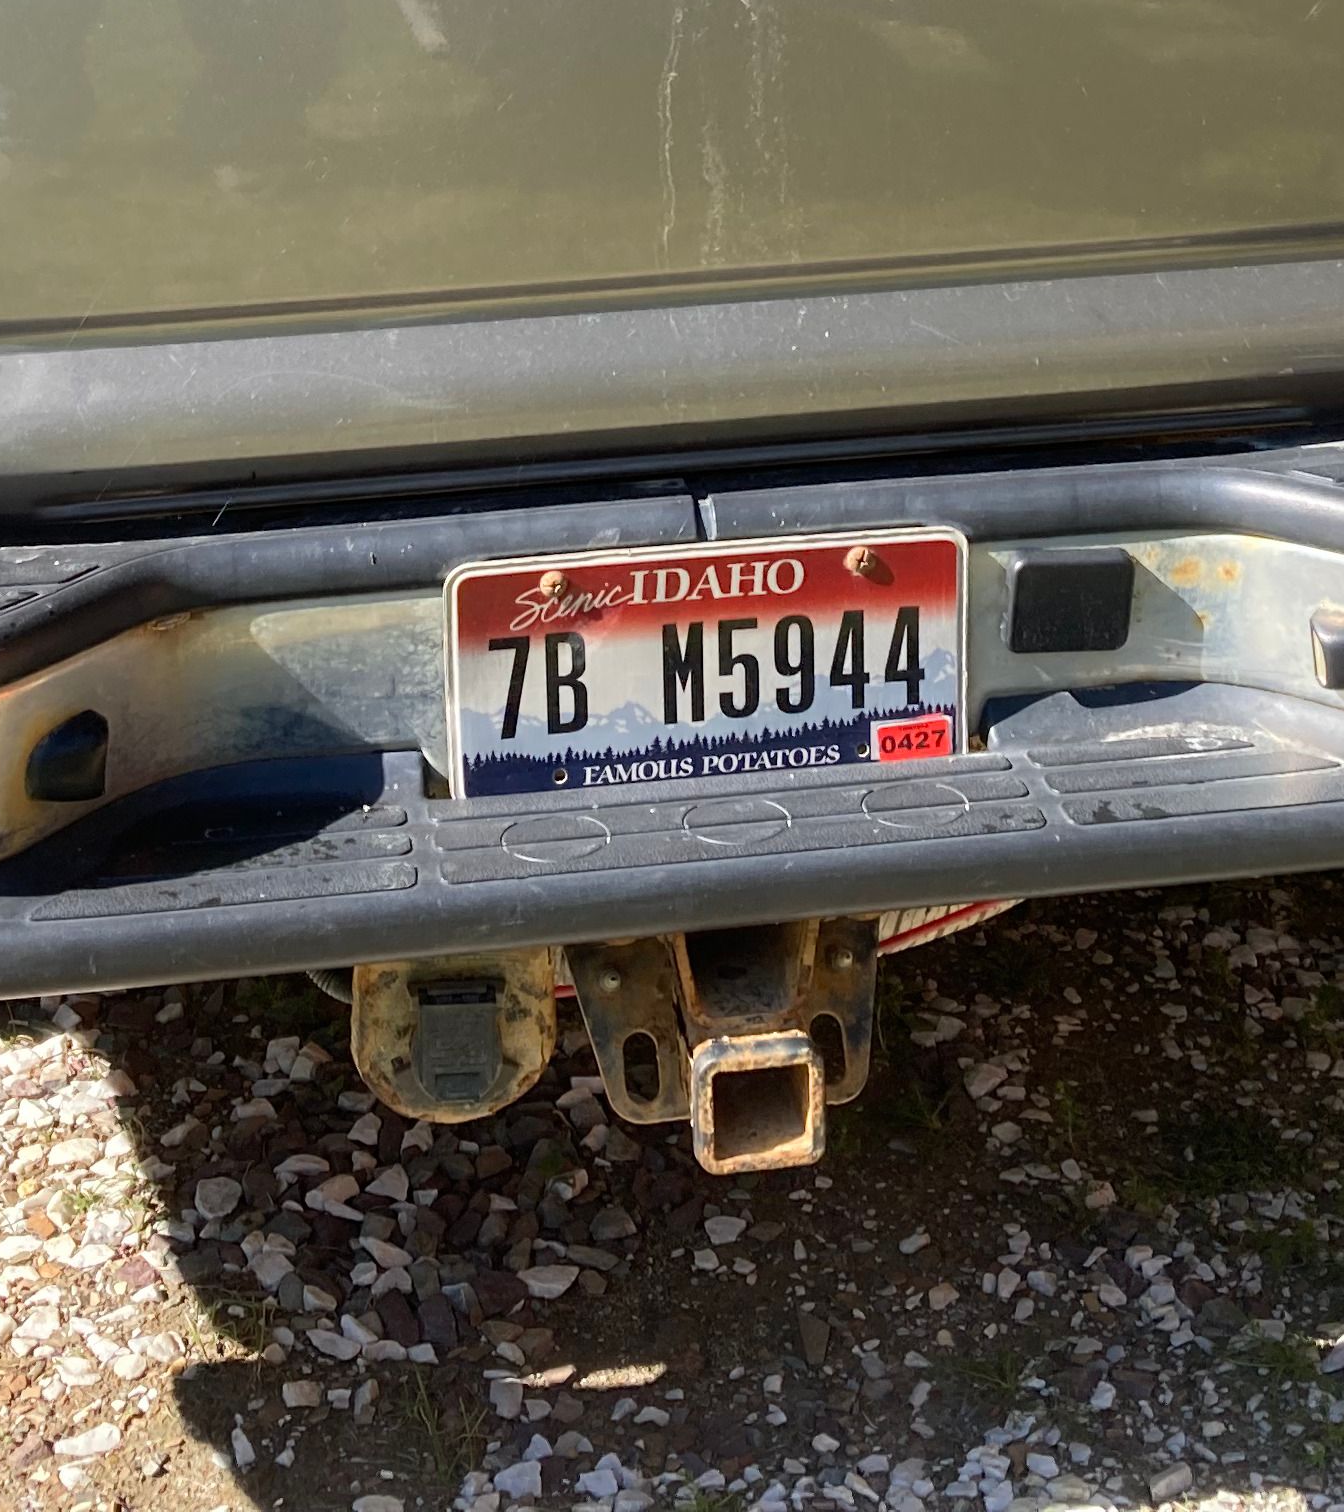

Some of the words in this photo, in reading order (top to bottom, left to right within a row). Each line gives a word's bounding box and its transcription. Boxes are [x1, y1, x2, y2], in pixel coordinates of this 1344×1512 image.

[509, 583, 634, 631] Scenic
[627, 558, 805, 605] IDAHO
[488, 632, 589, 740] 7B
[661, 606, 926, 725] M5944
[582, 757, 694, 787] FAMOUS
[701, 744, 841, 775] POTATOES
[881, 729, 946, 754] 0427
